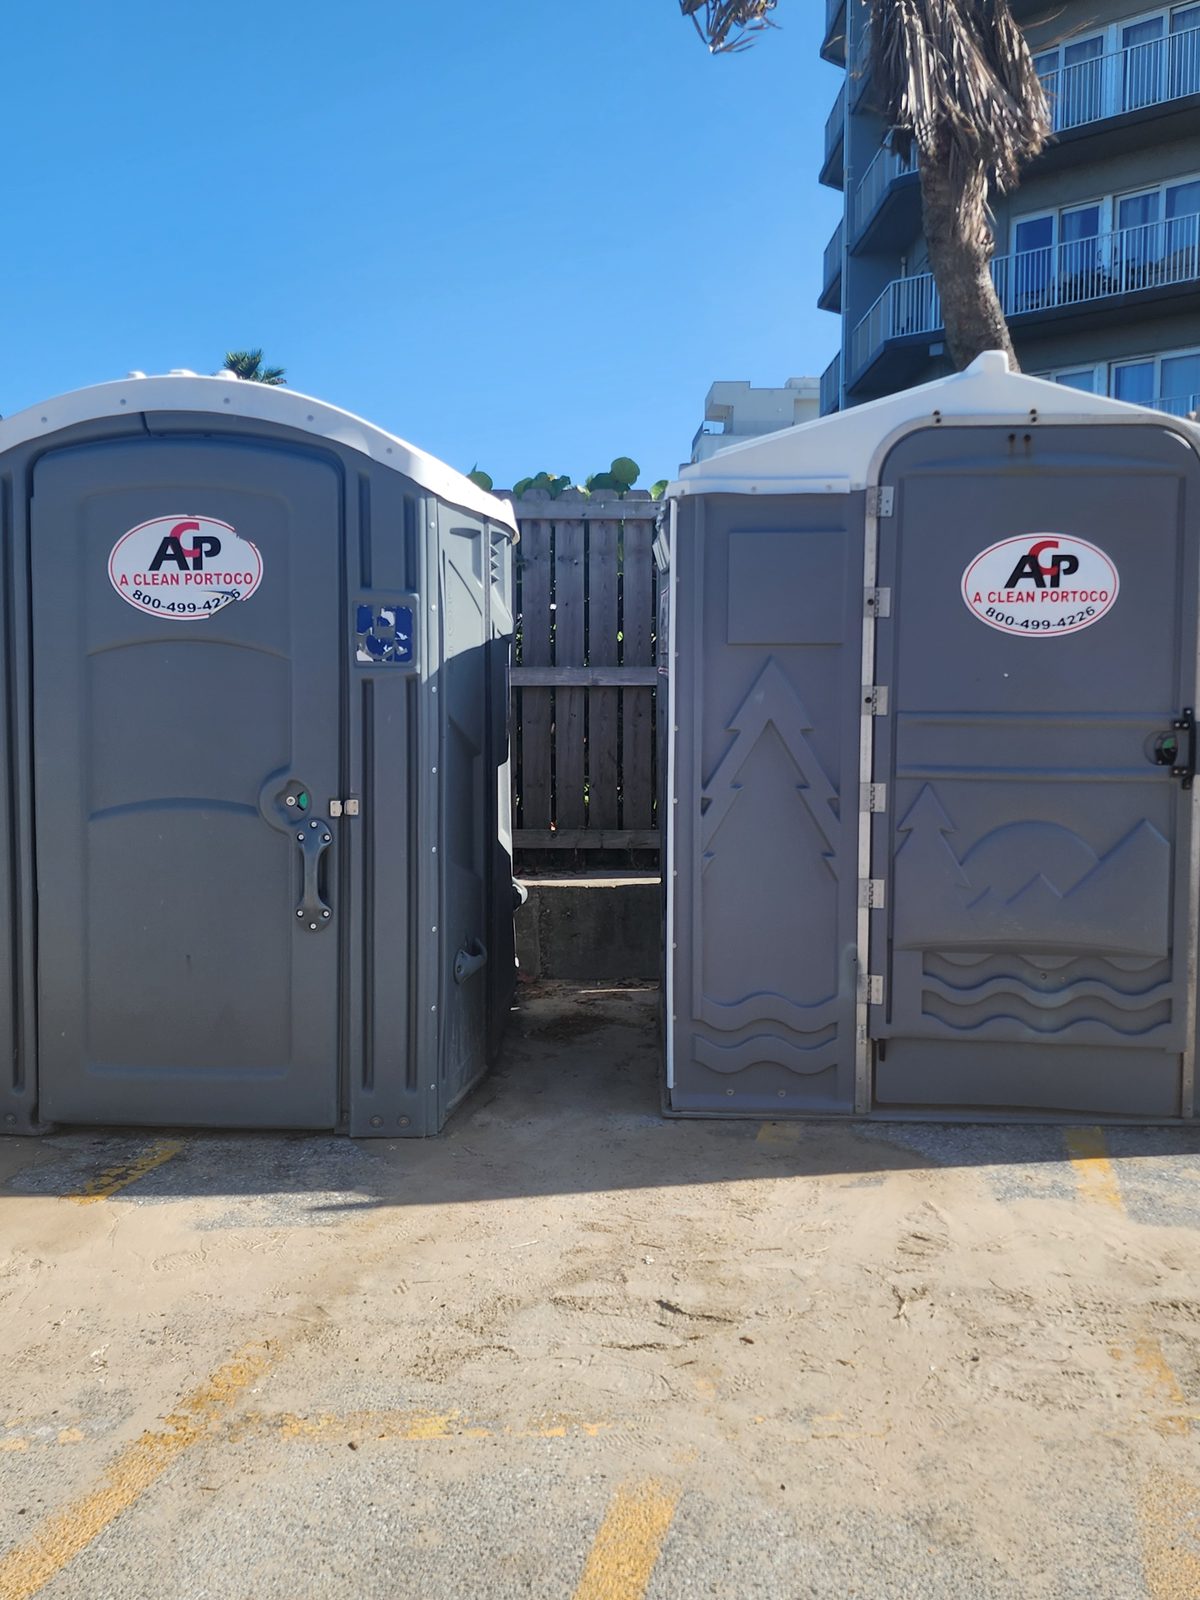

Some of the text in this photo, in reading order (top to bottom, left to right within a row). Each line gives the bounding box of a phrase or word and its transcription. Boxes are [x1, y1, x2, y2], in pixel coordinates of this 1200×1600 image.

[119, 572, 253, 586] A CLEAN PORTOCO
[973, 590, 1108, 604] A CLEAN PORTOCO
[985, 606, 1095, 630] 800-499-4226
